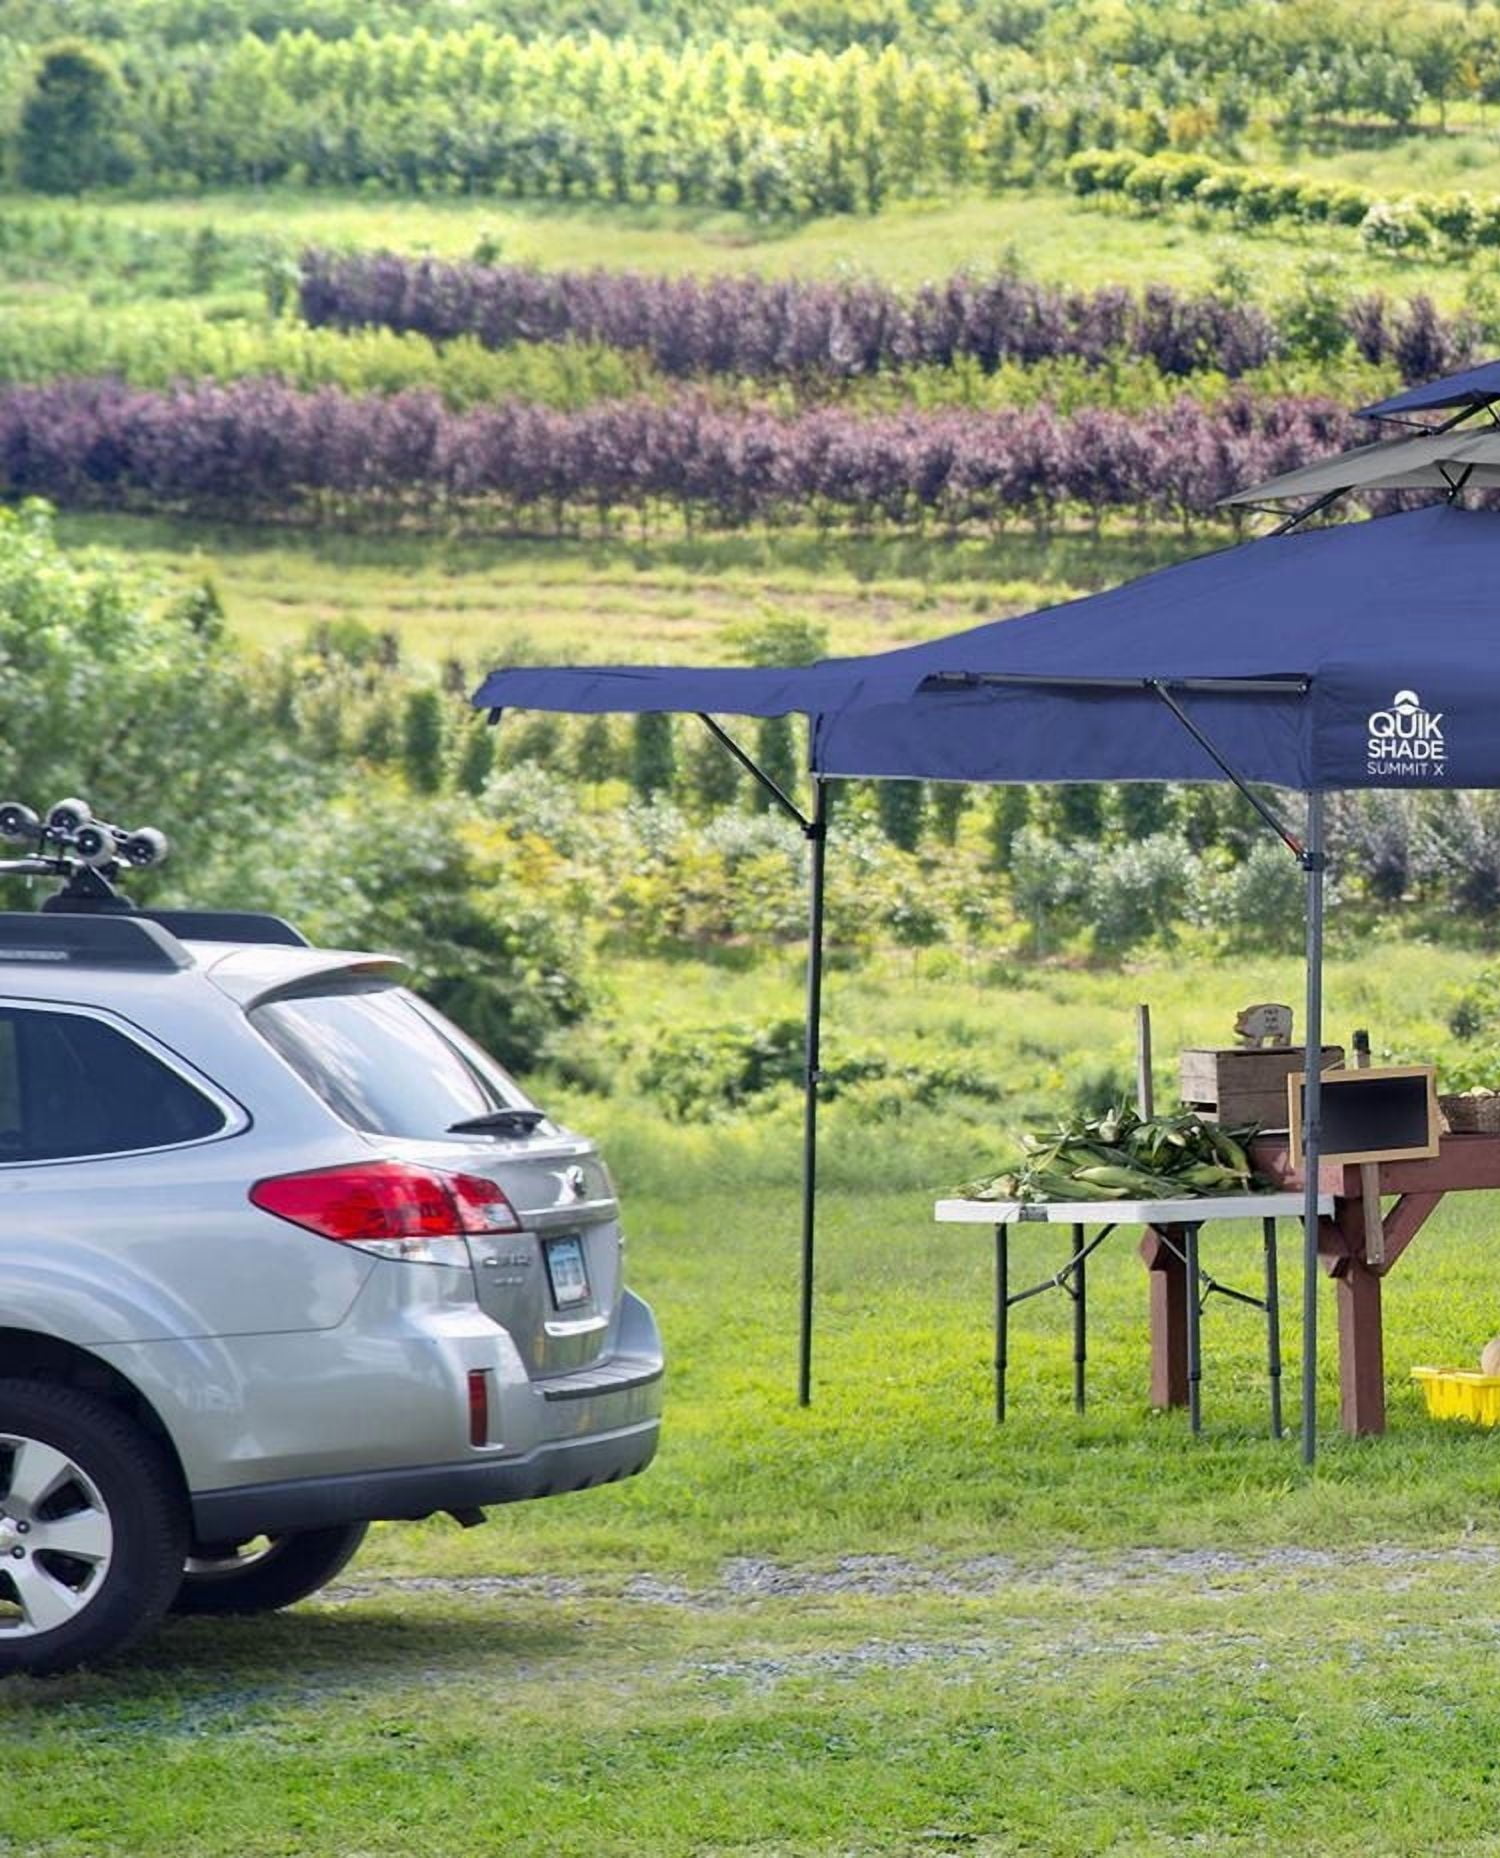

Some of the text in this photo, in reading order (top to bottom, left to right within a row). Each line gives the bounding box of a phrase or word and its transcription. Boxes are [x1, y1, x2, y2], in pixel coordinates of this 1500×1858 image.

[1368, 711, 1444, 739] QUIK
[1367, 738, 1446, 760] SHADE
[1366, 761, 1445, 776] SUMMIT X
